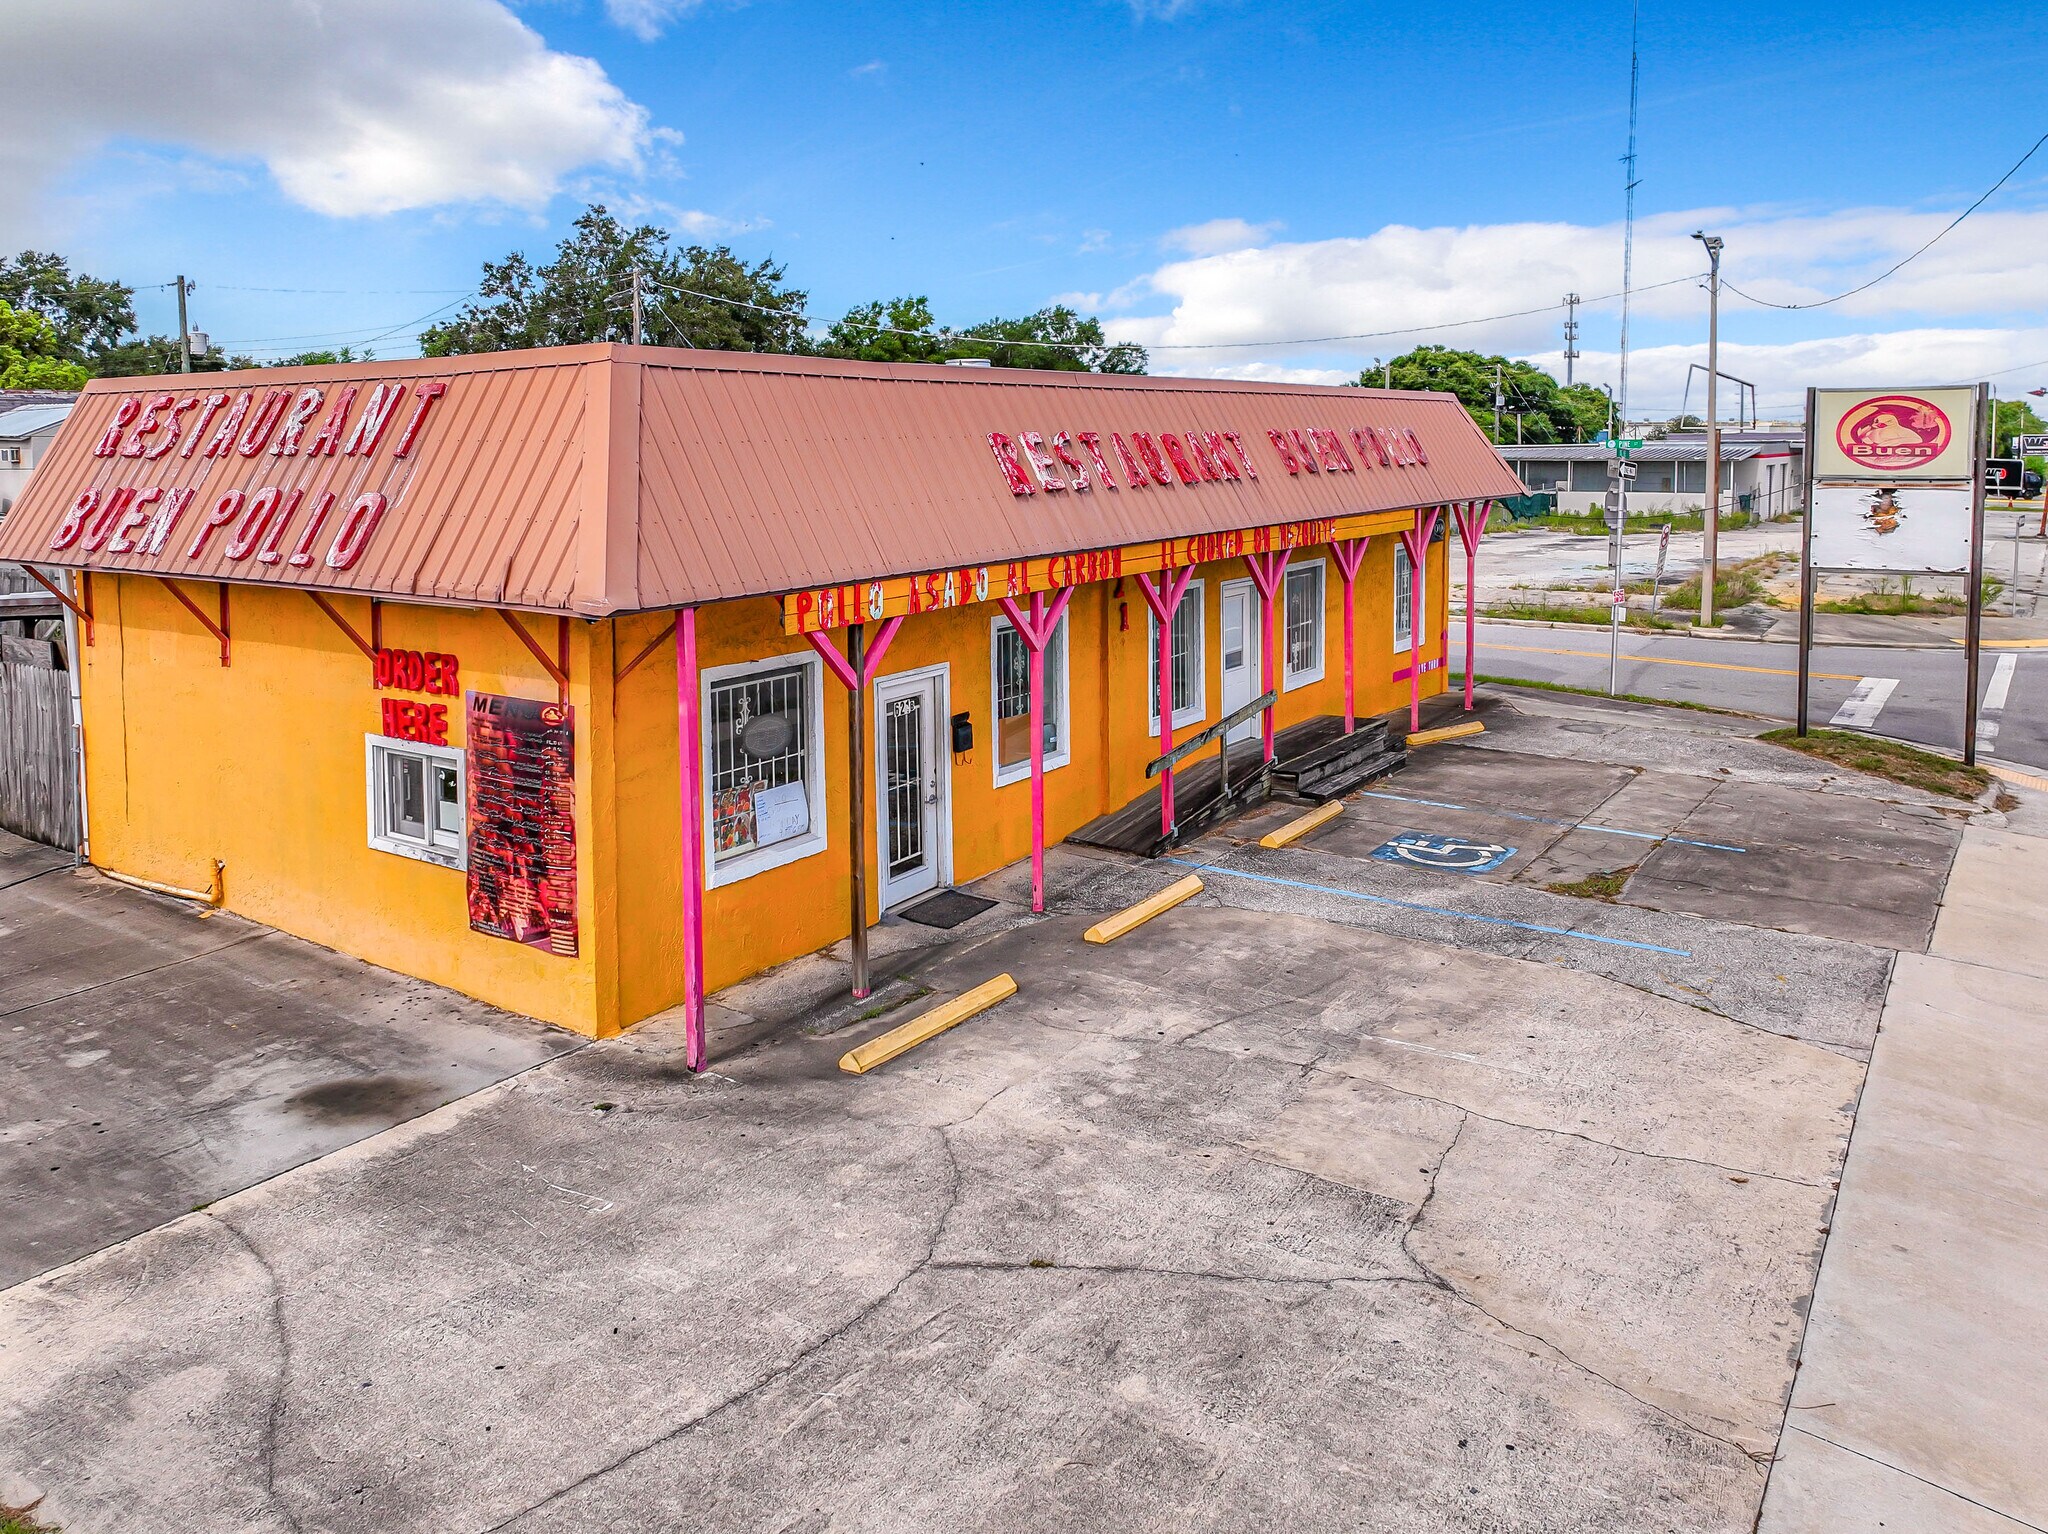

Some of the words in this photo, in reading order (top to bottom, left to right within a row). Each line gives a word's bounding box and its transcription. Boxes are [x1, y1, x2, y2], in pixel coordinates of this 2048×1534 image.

[93, 382, 447, 460] RESTAURANT
[1852, 445, 1932, 456] Buen
[986, 429, 1258, 496] RESTAURANT
[1267, 427, 1354, 475] BUEN
[1349, 426, 1429, 470] POLLO
[49, 486, 197, 556] BUEN
[187, 487, 388, 571] POLLO
[797, 581, 884, 635] POLLO
[908, 567, 989, 615] ASADO
[1007, 561, 1031, 597] AL
[1048, 547, 1122, 589] CARBON
[1187, 529, 1243, 565] COOKED
[1254, 526, 1271, 553] ON
[376, 648, 459, 696] ORDER
[381, 697, 448, 747] HERE
